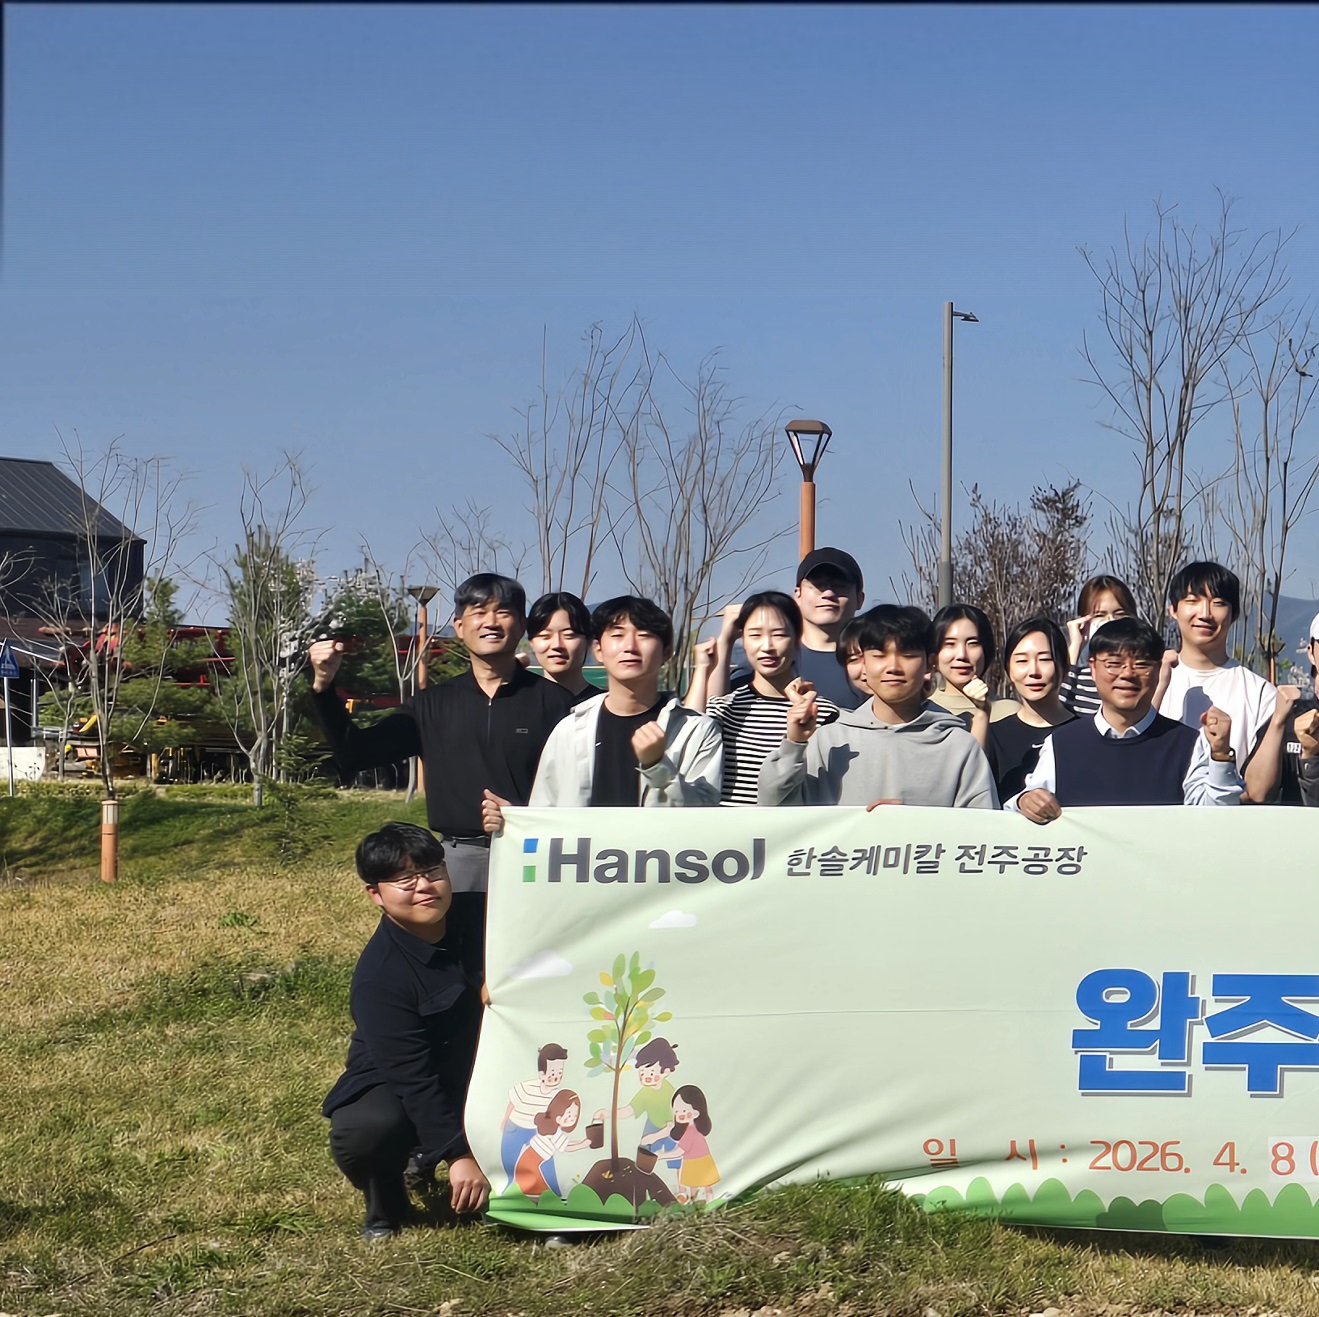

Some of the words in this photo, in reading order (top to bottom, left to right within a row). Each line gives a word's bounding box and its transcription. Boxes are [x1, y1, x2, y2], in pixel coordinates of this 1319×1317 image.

[548, 838, 766, 884] Hansol
[787, 844, 945, 878] 한솔케미칼
[954, 844, 1088, 876] 전주공장
[922, 1138, 959, 1168] 일
[1005, 1138, 1039, 1171] 시
[1088, 1140, 1191, 1174] 2026.
[1212, 1141, 1247, 1174] 4.
